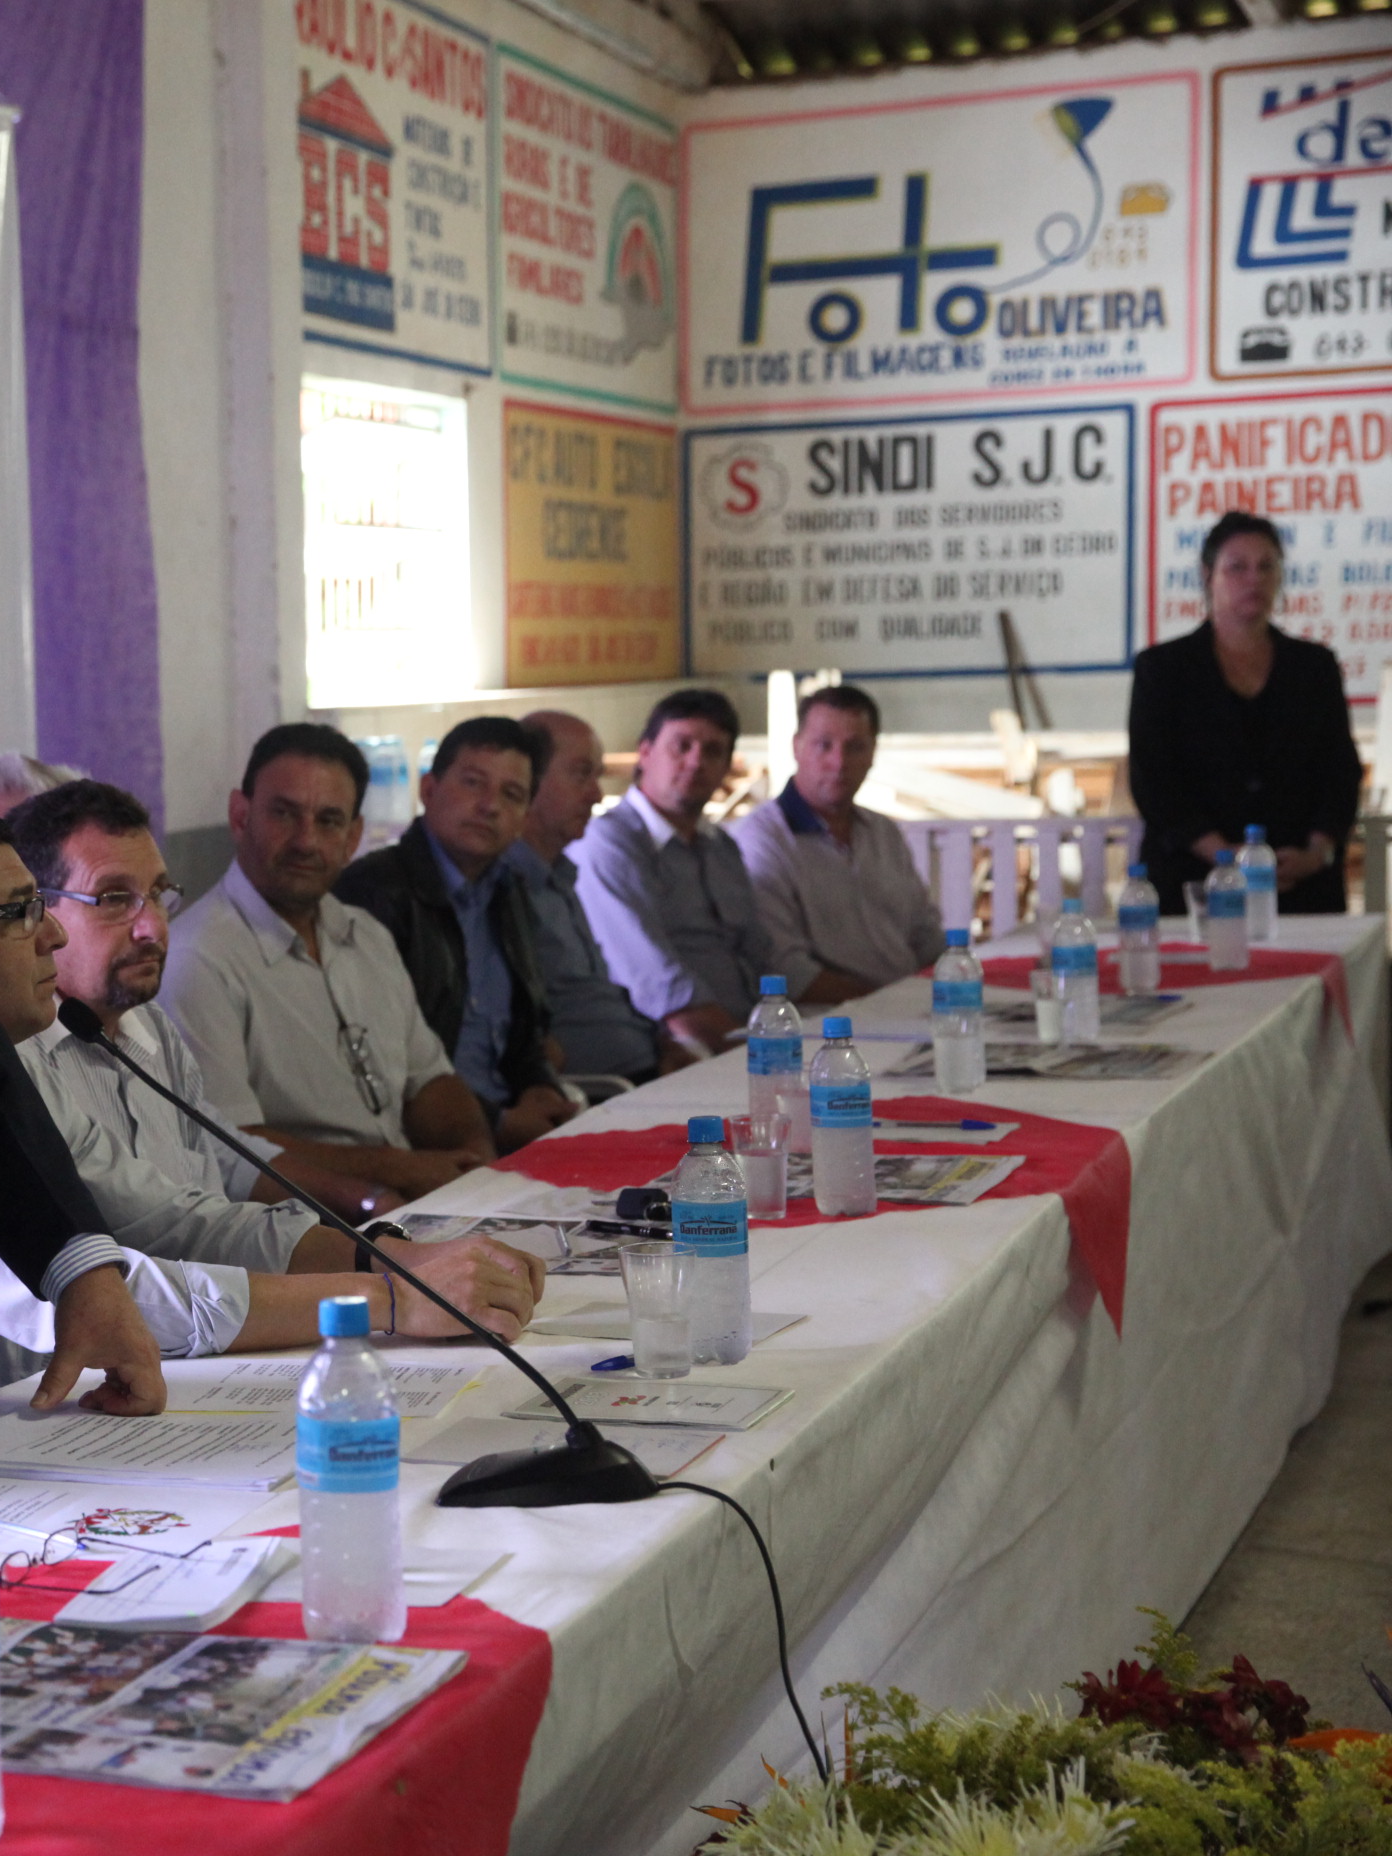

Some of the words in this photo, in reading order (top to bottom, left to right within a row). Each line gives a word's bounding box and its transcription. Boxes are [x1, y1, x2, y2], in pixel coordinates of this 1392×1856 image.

[298, 131, 392, 275] BCS
[997, 287, 1167, 339] OLIVEIRA
[705, 353, 789, 387] FOTOS
[822, 341, 985, 383] FILMAGENS
[723, 458, 761, 515] S
[808, 433, 934, 497] SINDI
[784, 509, 878, 533] SINDICATO
[940, 499, 1063, 527] SERVIDORES
[1167, 473, 1361, 518] PAINEIRA
[843, 571, 923, 603] DEFESA
[972, 566, 1064, 600] SERVIÇO
[680, 1224, 737, 1236] Danferrana
